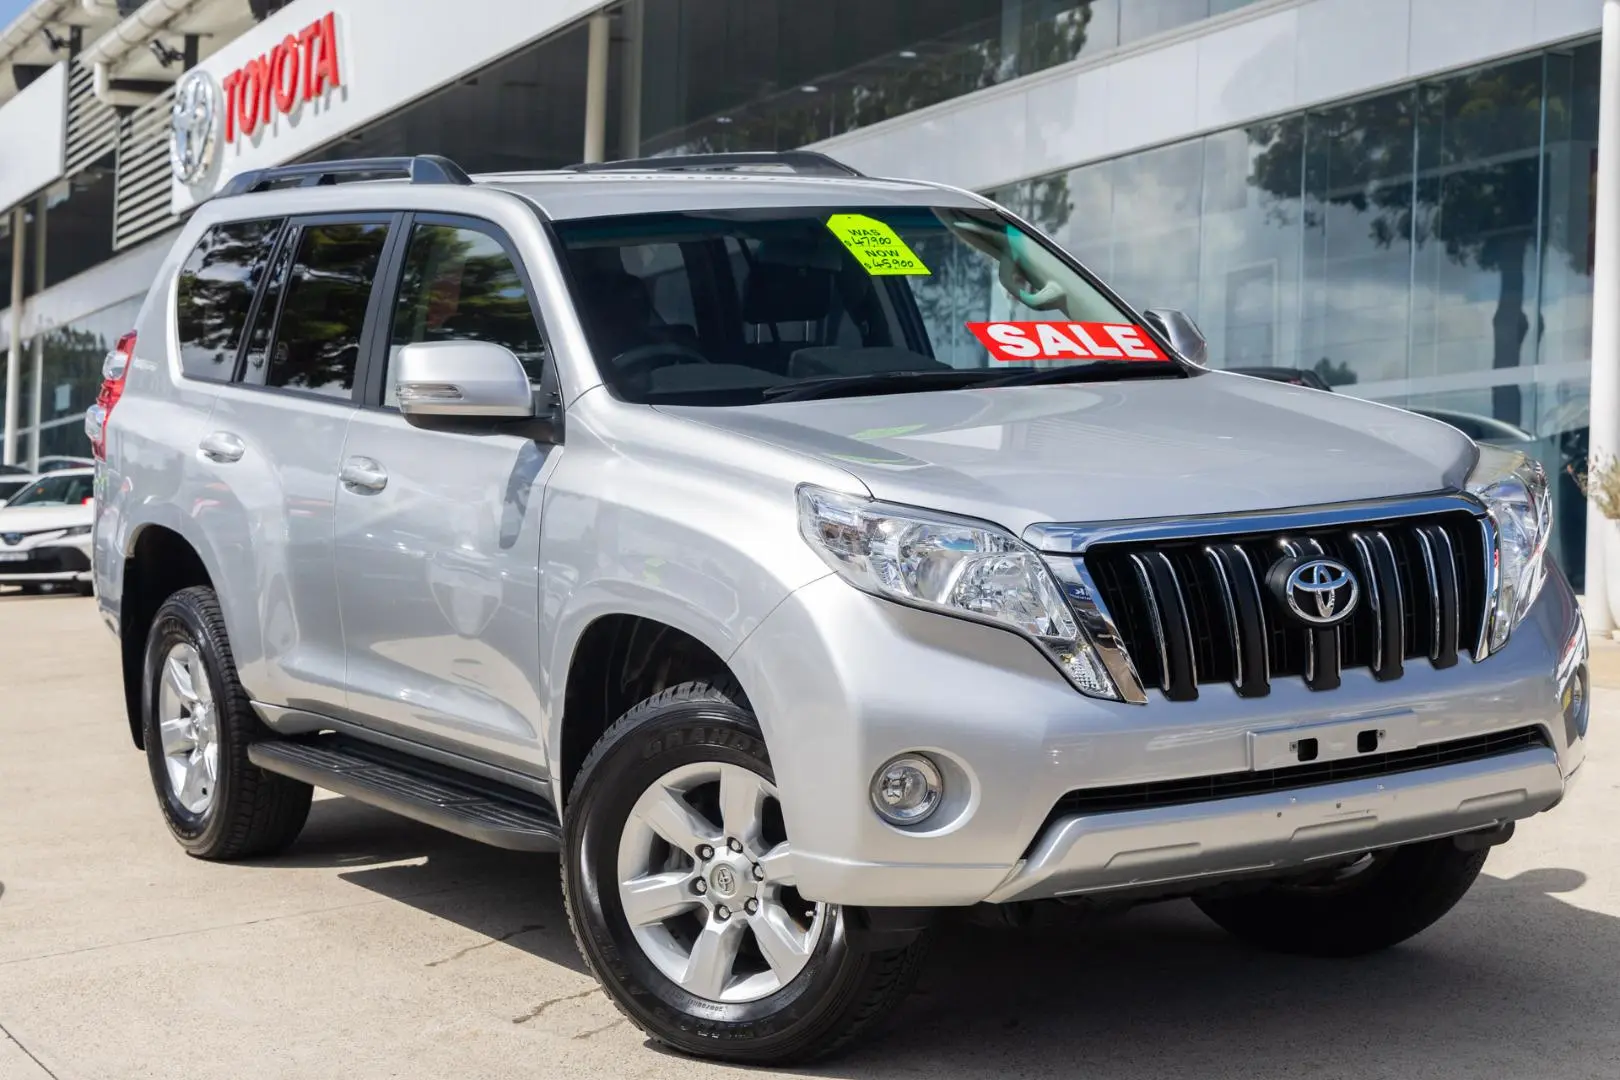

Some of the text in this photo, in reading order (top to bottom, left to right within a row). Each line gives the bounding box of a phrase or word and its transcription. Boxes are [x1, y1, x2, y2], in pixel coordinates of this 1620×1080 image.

[223, 11, 340, 143] TOYOTA
[864, 249, 900, 257] NOW
[986, 323, 1158, 358] SALE
